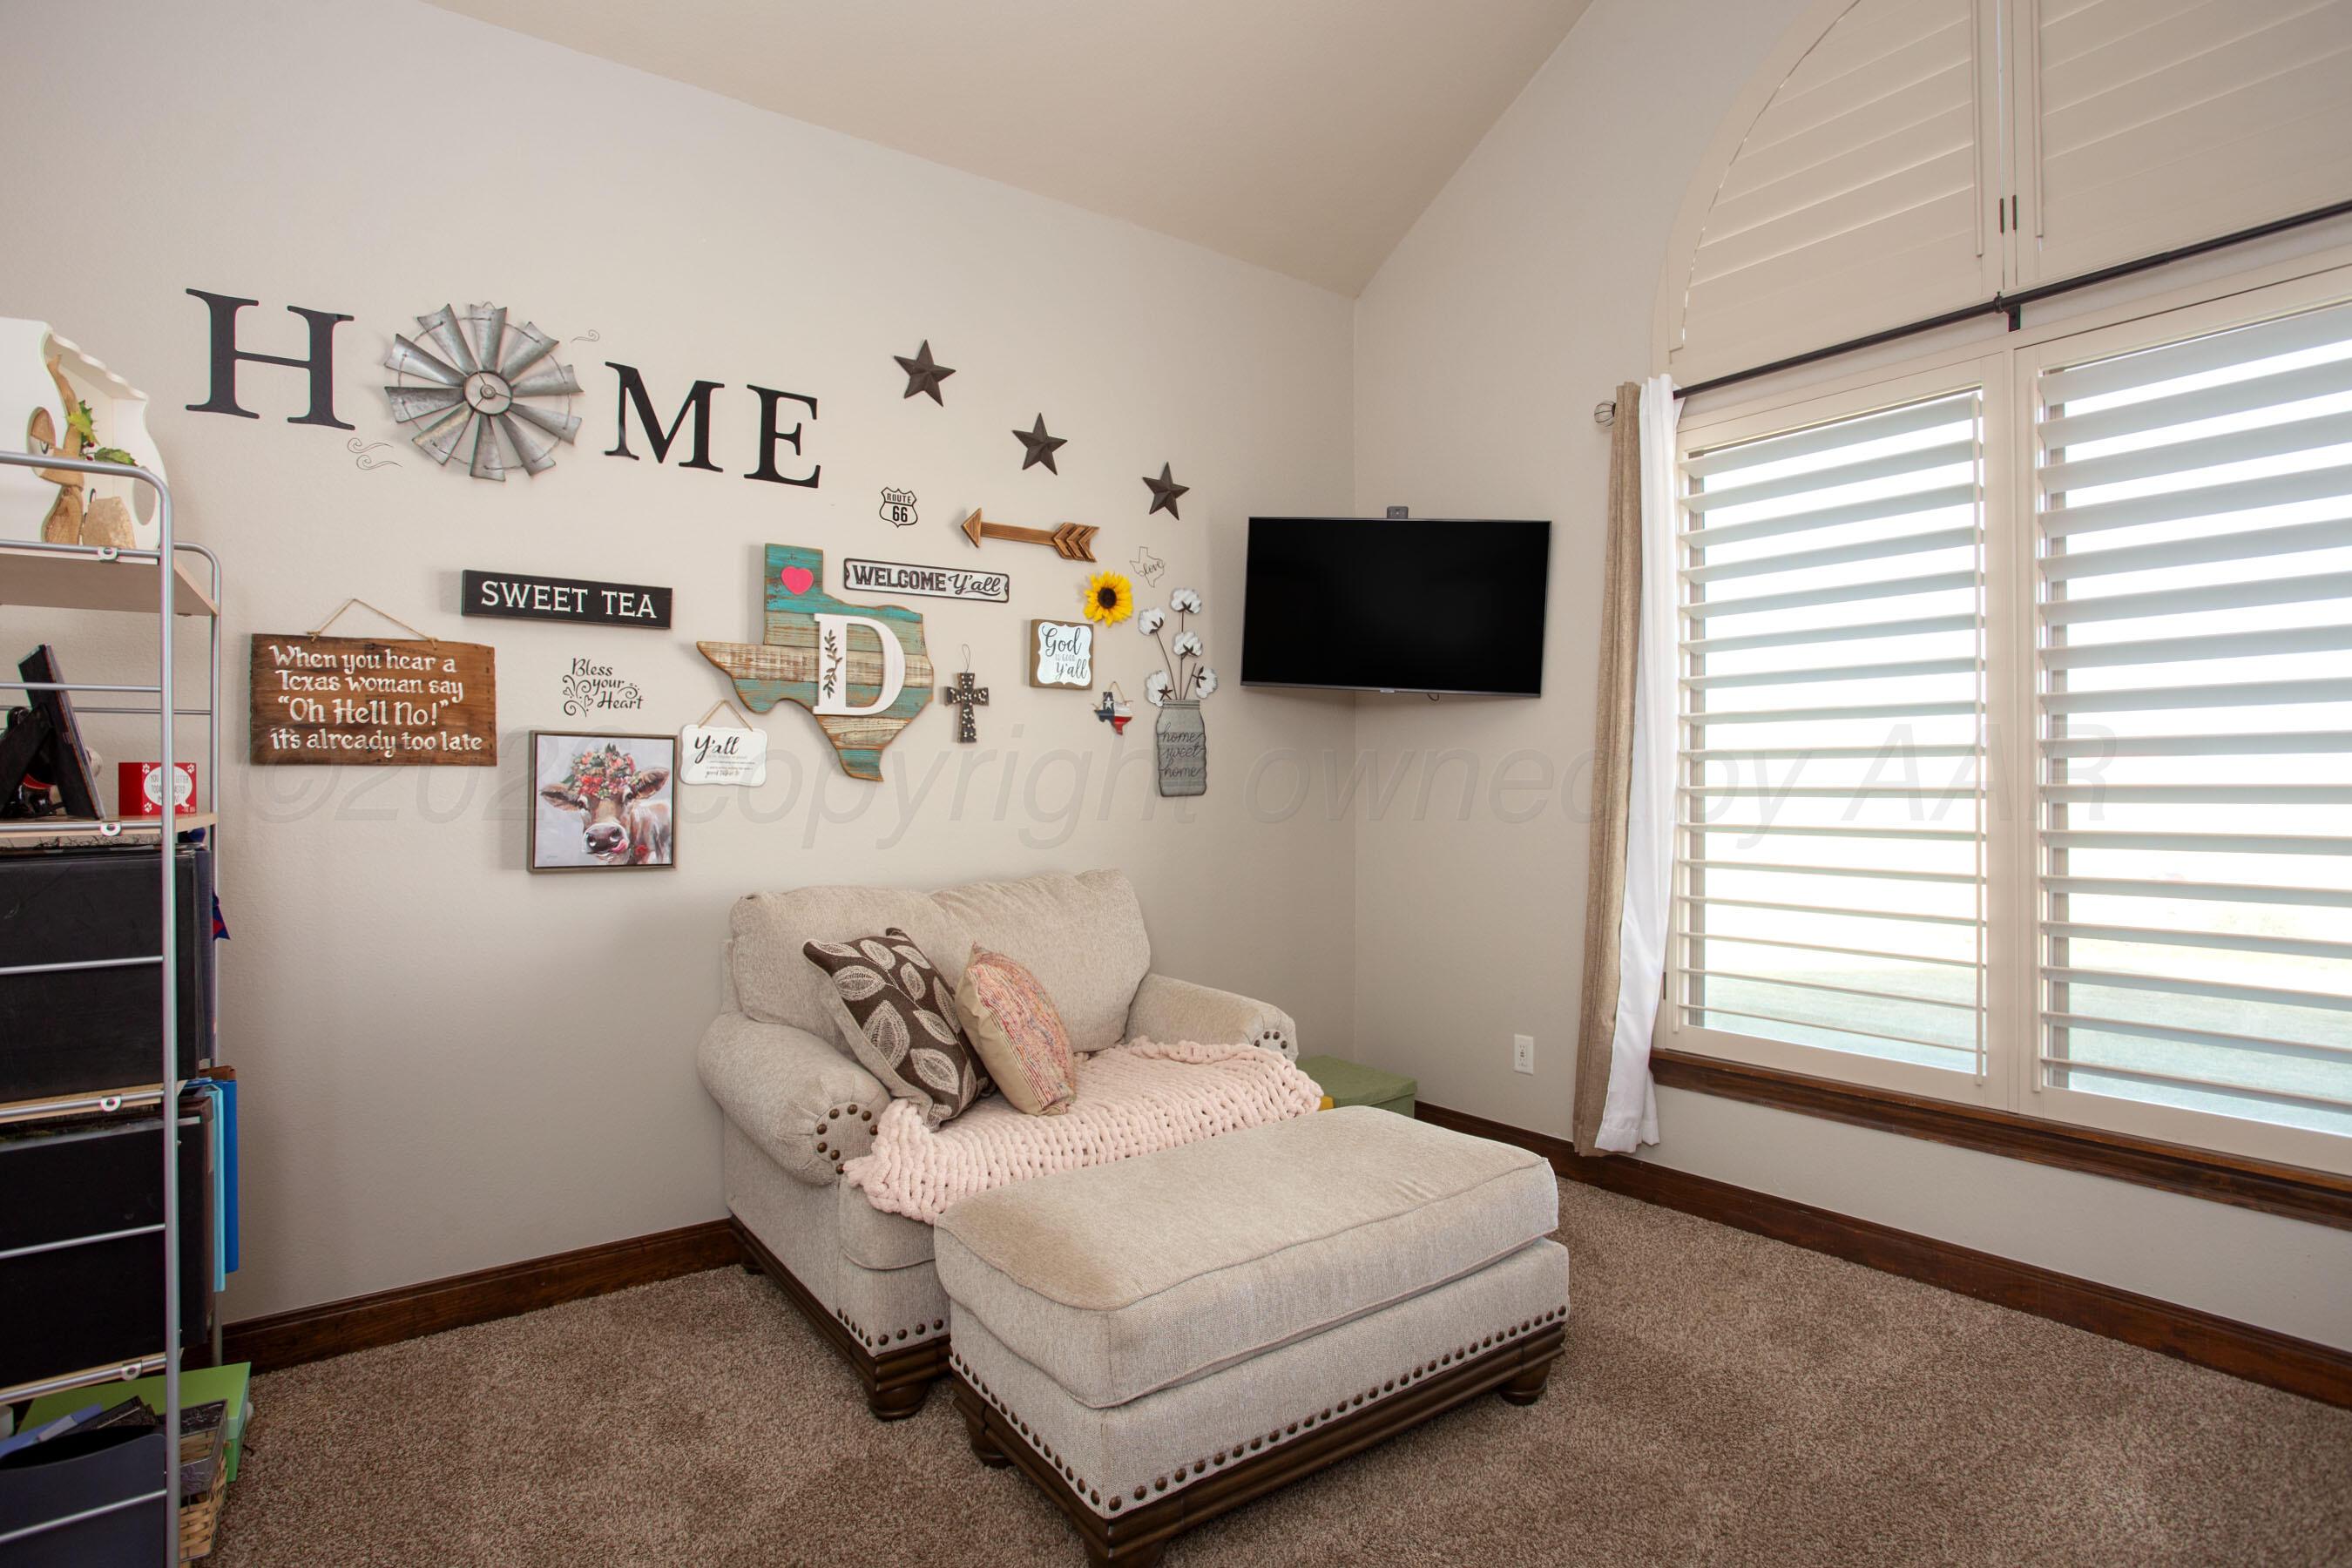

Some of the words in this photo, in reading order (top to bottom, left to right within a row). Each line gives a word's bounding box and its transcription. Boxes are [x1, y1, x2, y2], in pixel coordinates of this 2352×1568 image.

[887, 493, 911, 504] ROUTE
[892, 505, 908, 523] 66
[852, 564, 946, 591] WELCOME
[948, 573, 1001, 596] Y'all
[481, 580, 588, 613] SWEET
[601, 590, 657, 618] TEA
[1042, 625, 1082, 657] God
[268, 645, 338, 669] When
[341, 653, 381, 674] you
[386, 649, 436, 670] hear
[443, 659, 458, 672] a
[571, 658, 613, 676] Bless
[813, 613, 905, 715] D
[274, 669, 341, 692] Texas
[345, 676, 424, 693] woman
[429, 679, 463, 703] say
[592, 678, 625, 696] your
[332, 698, 389, 726] Hell
[597, 691, 644, 710] Heart
[306, 728, 395, 758] already
[401, 732, 436, 750] too
[440, 730, 483, 752] late
[1159, 722, 1203, 743] home
[694, 735, 740, 764] Y'all
[1159, 766, 1202, 777] home
